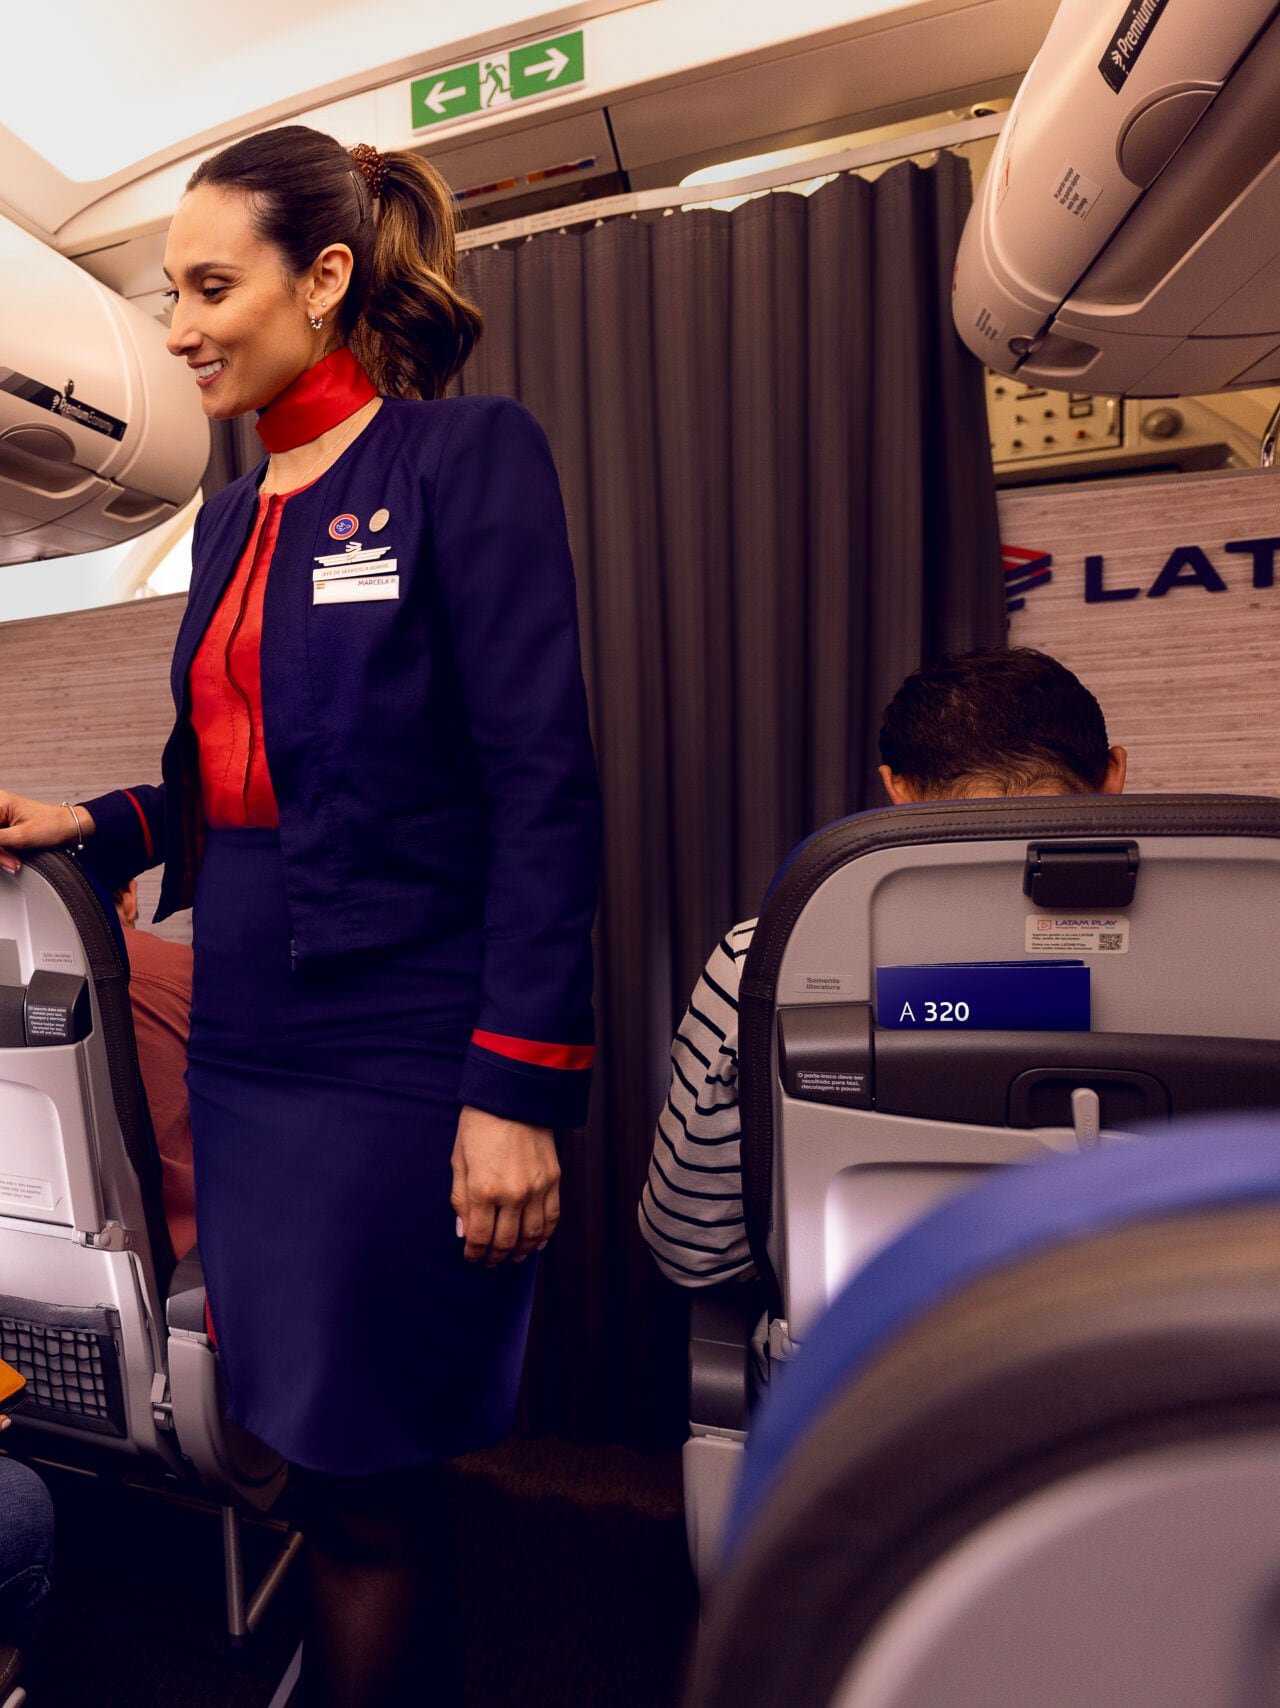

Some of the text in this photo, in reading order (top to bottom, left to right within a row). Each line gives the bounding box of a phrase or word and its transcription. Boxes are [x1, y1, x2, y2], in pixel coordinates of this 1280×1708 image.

[358, 578, 389, 586] MARCELA
[899, 1002, 970, 1022] A 320
